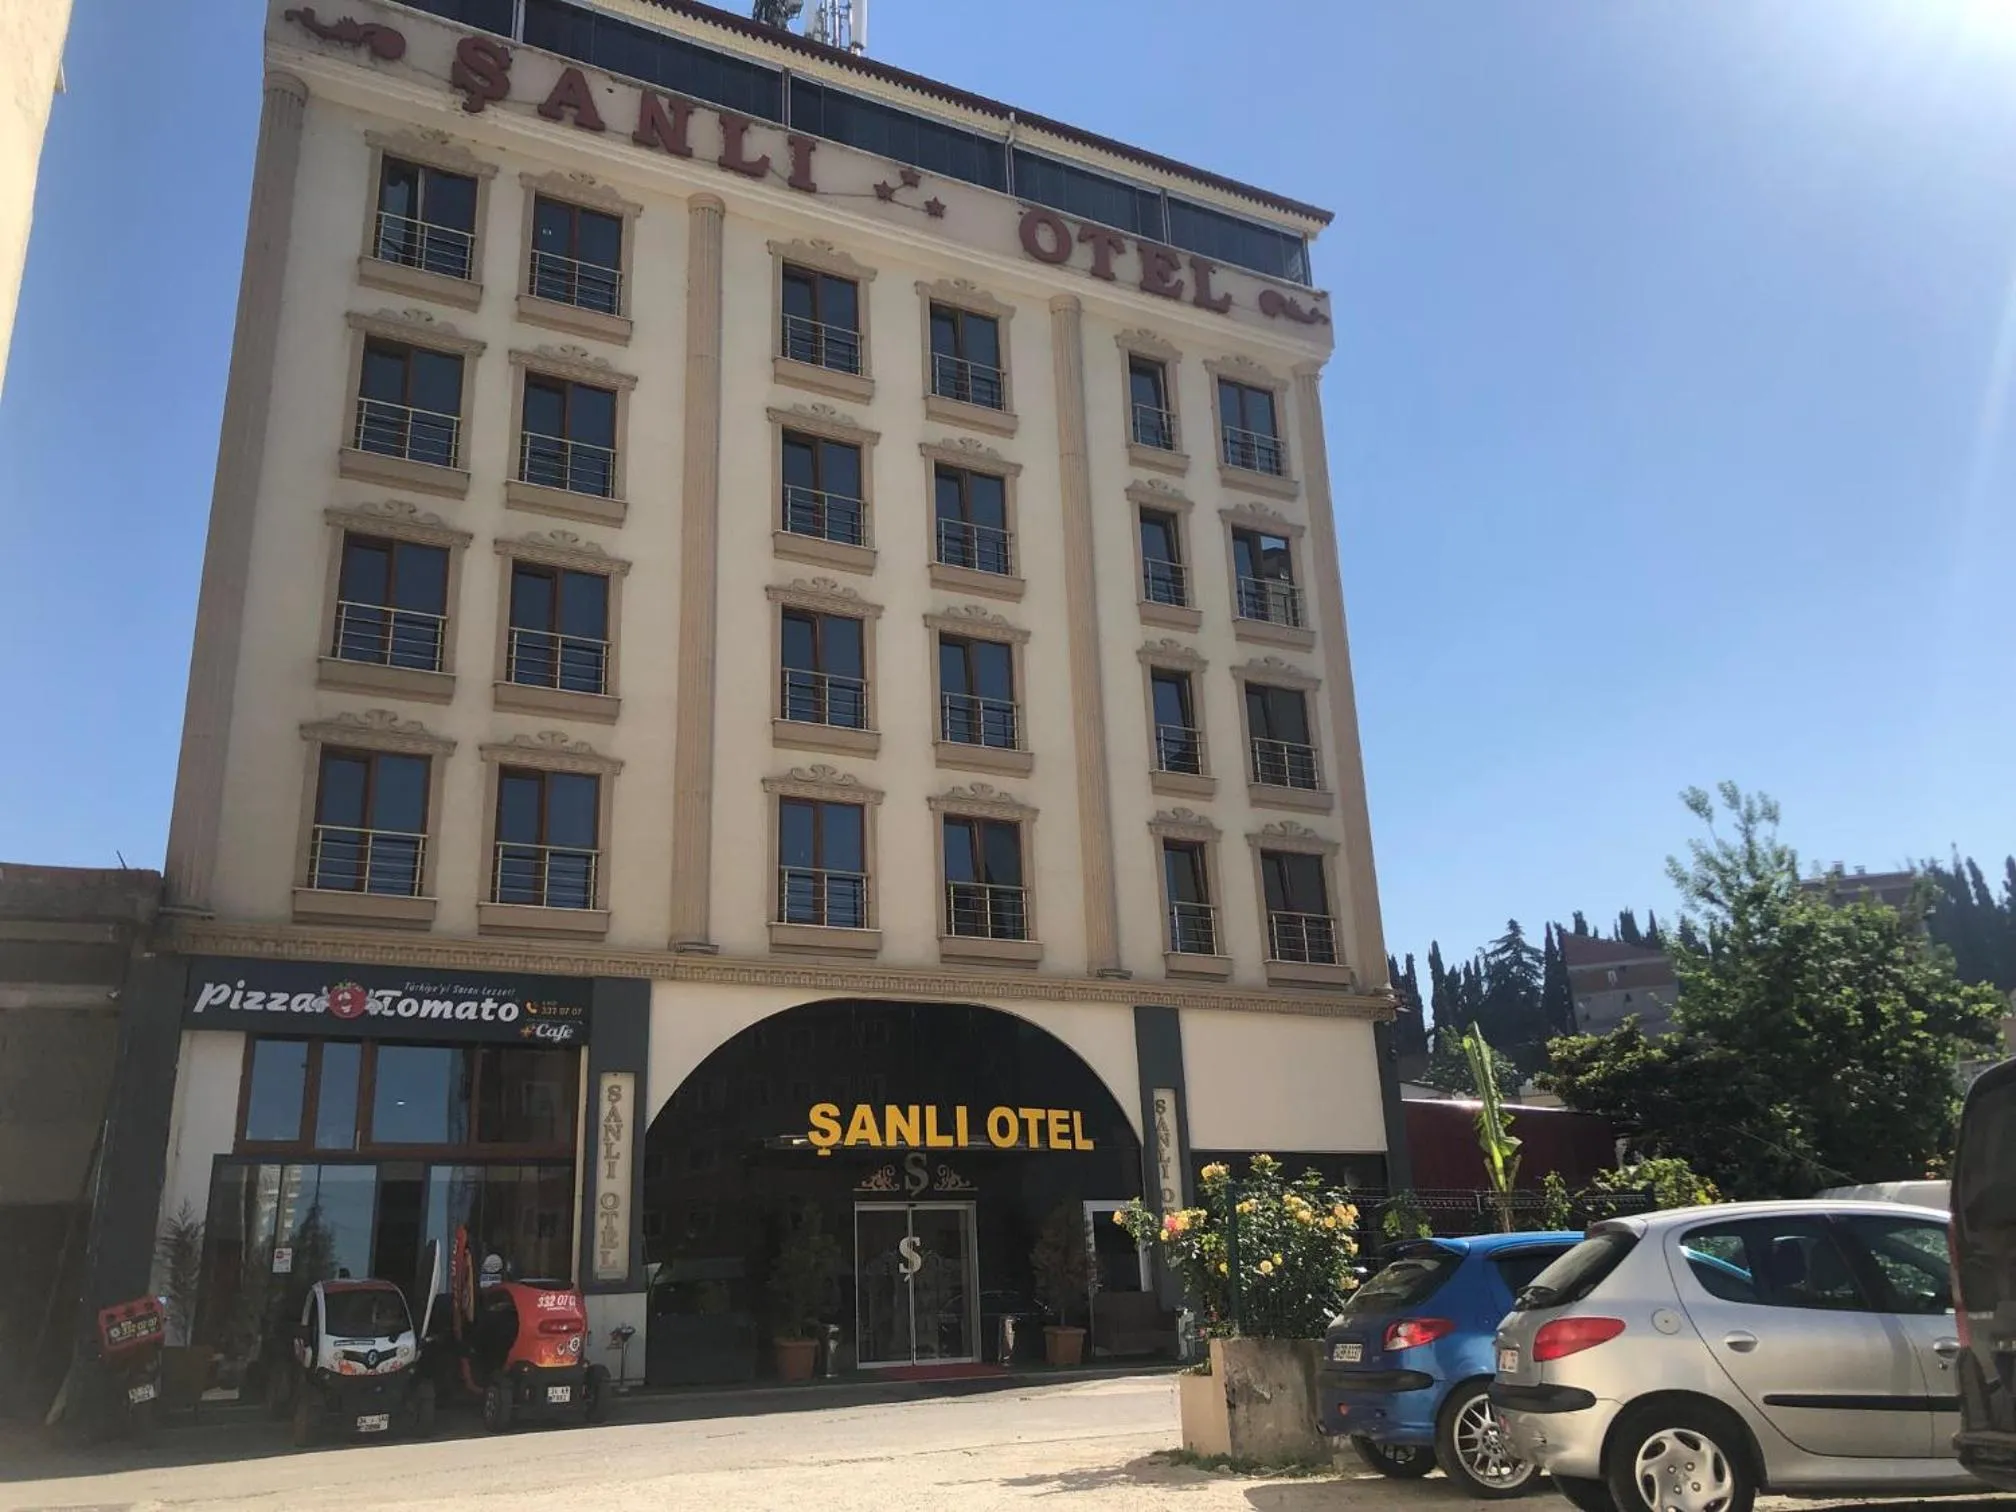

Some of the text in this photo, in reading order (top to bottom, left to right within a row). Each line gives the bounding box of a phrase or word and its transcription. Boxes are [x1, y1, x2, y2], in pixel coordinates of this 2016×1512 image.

[452, 36, 1233, 314] ŞANLI OTEL
[374, 988, 519, 1022] Tomato
[807, 1103, 1095, 1156] ŞANLI OTEL
[599, 1191, 620, 1270] OTEL
